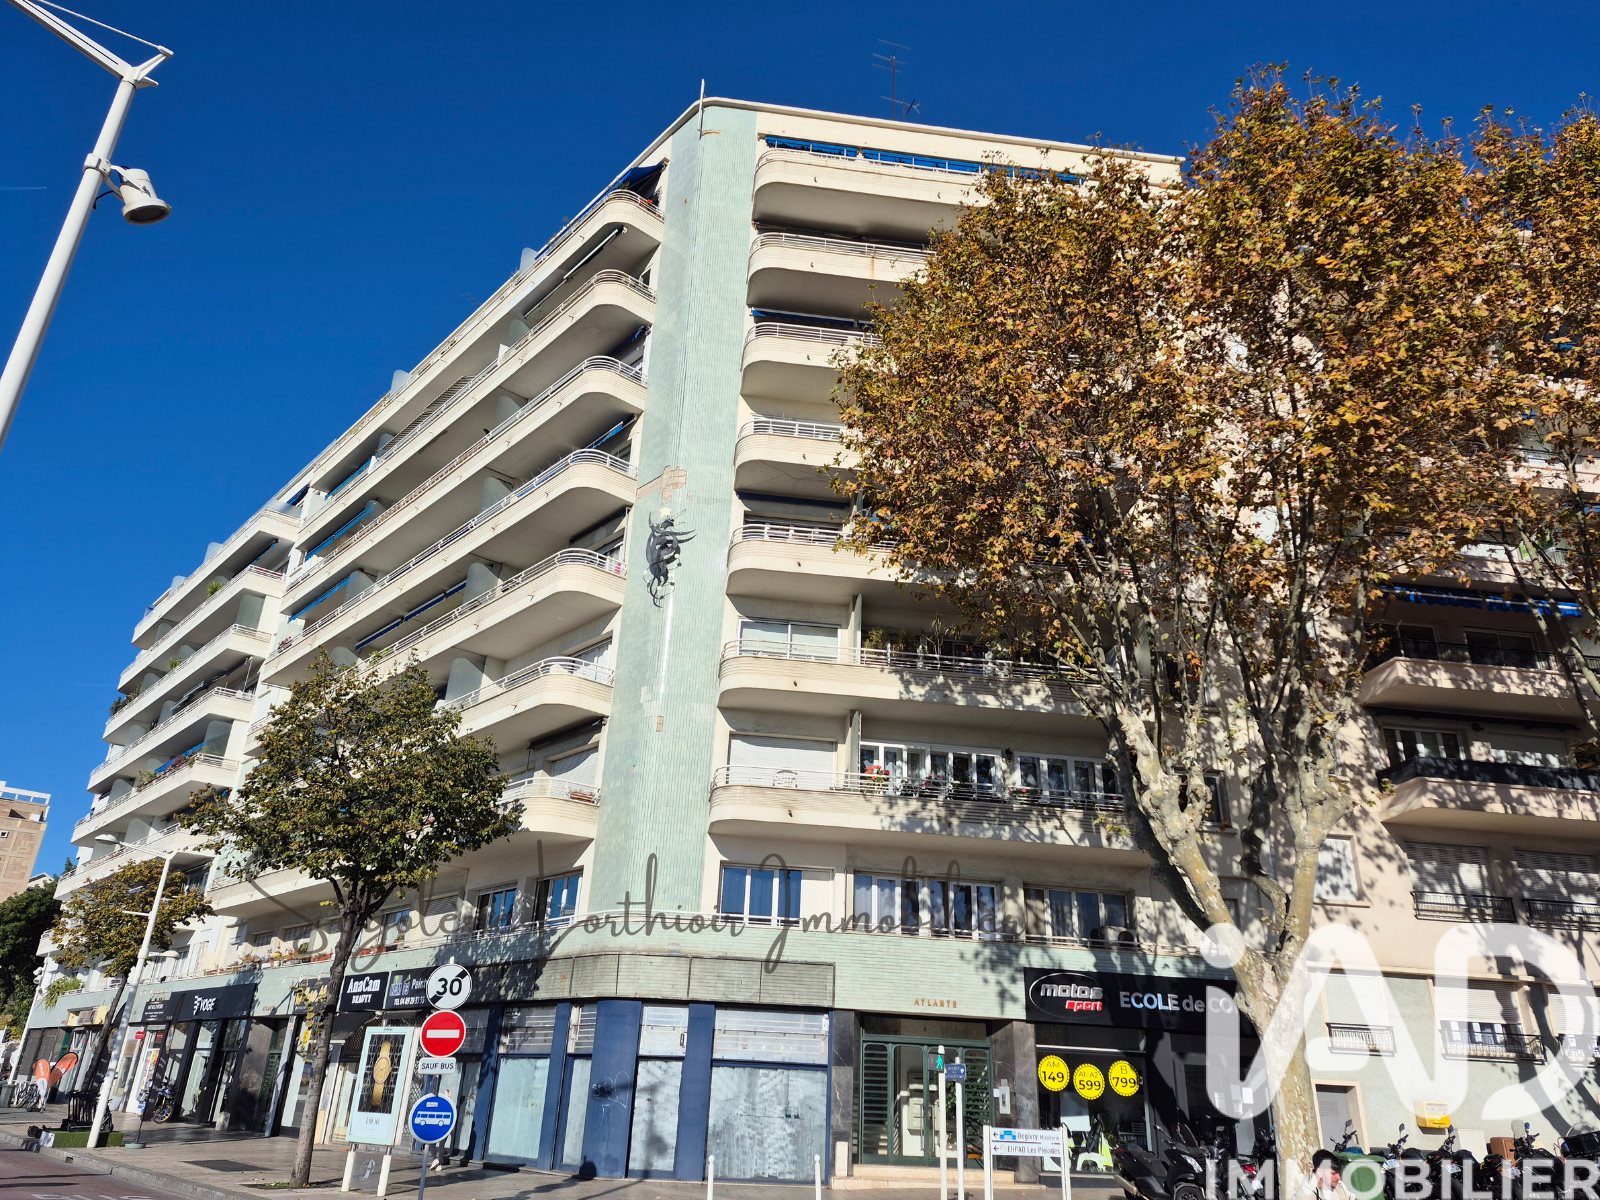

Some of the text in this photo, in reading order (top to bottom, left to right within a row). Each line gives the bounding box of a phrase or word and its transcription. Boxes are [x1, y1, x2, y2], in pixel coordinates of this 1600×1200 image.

[436, 977, 462, 996] 30
[1040, 983, 1103, 999] motos
[1119, 991, 1180, 1011] ECOLE
[1182, 998, 1206, 1013] de
[1046, 1060, 1061, 1069] AM
[1120, 1064, 1128, 1075] B
[1042, 1070, 1065, 1084] 149
[1112, 1076, 1136, 1089] 799
[1078, 1079, 1101, 1092] 599
